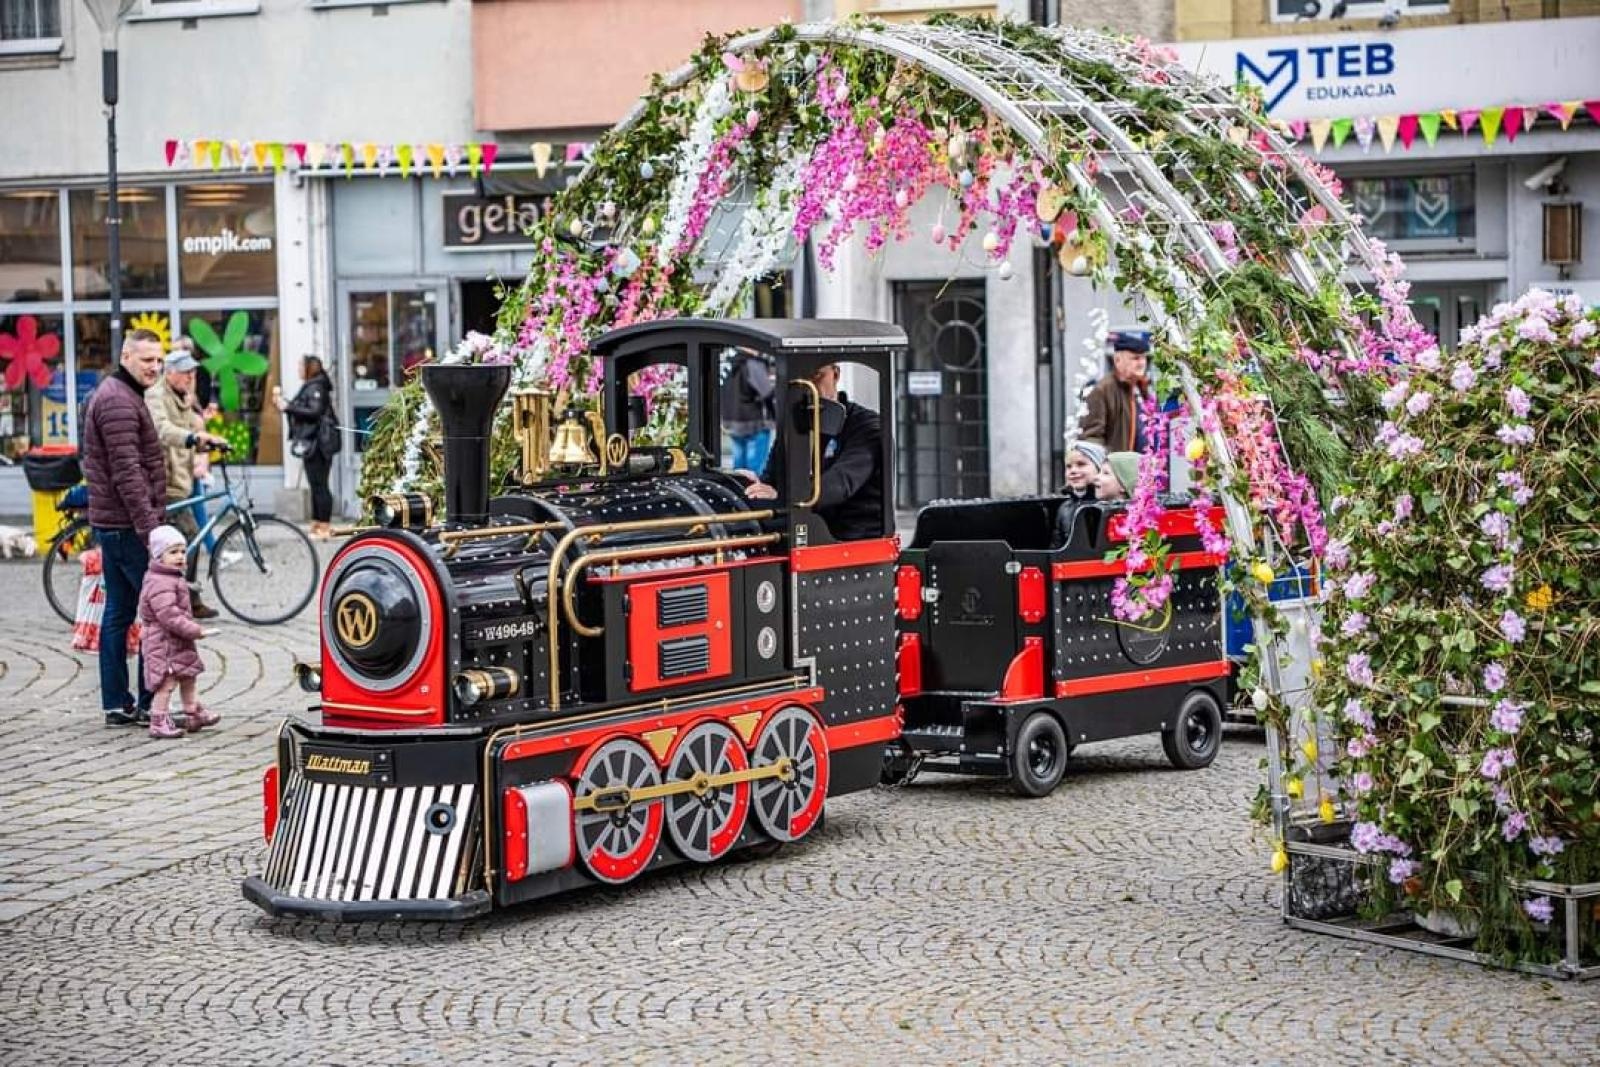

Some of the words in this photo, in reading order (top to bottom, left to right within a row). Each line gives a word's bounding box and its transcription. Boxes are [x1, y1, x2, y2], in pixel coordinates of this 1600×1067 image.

[1307, 43, 1395, 79] TEB
[1306, 83, 1396, 100] EDUKACJA
[183, 227, 272, 256] empik.com
[340, 600, 374, 645] W
